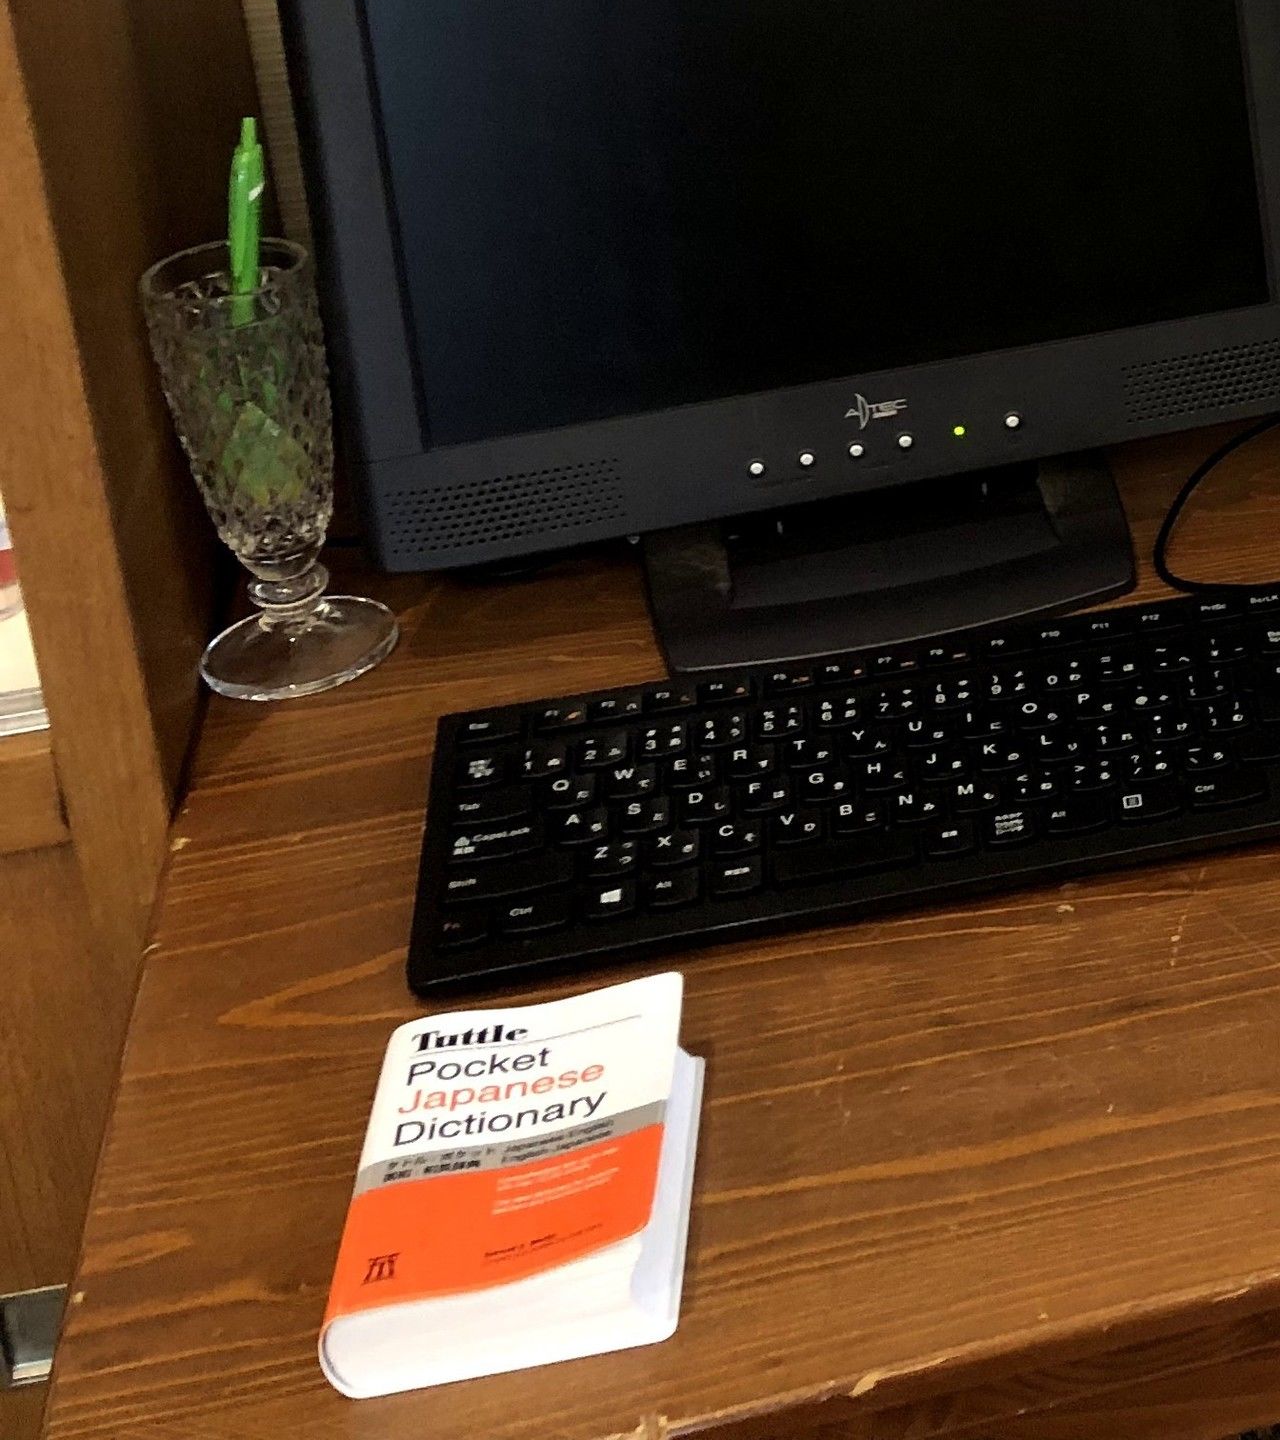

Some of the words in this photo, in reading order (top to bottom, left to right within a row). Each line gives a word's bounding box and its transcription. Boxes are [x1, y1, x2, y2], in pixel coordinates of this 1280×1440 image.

[614, 768, 634, 780] W
[412, 1025, 528, 1053] Tuttle
[407, 1047, 549, 1086] Pocket
[399, 1063, 605, 1113] Japanese
[393, 1092, 607, 1147] Dictionary
